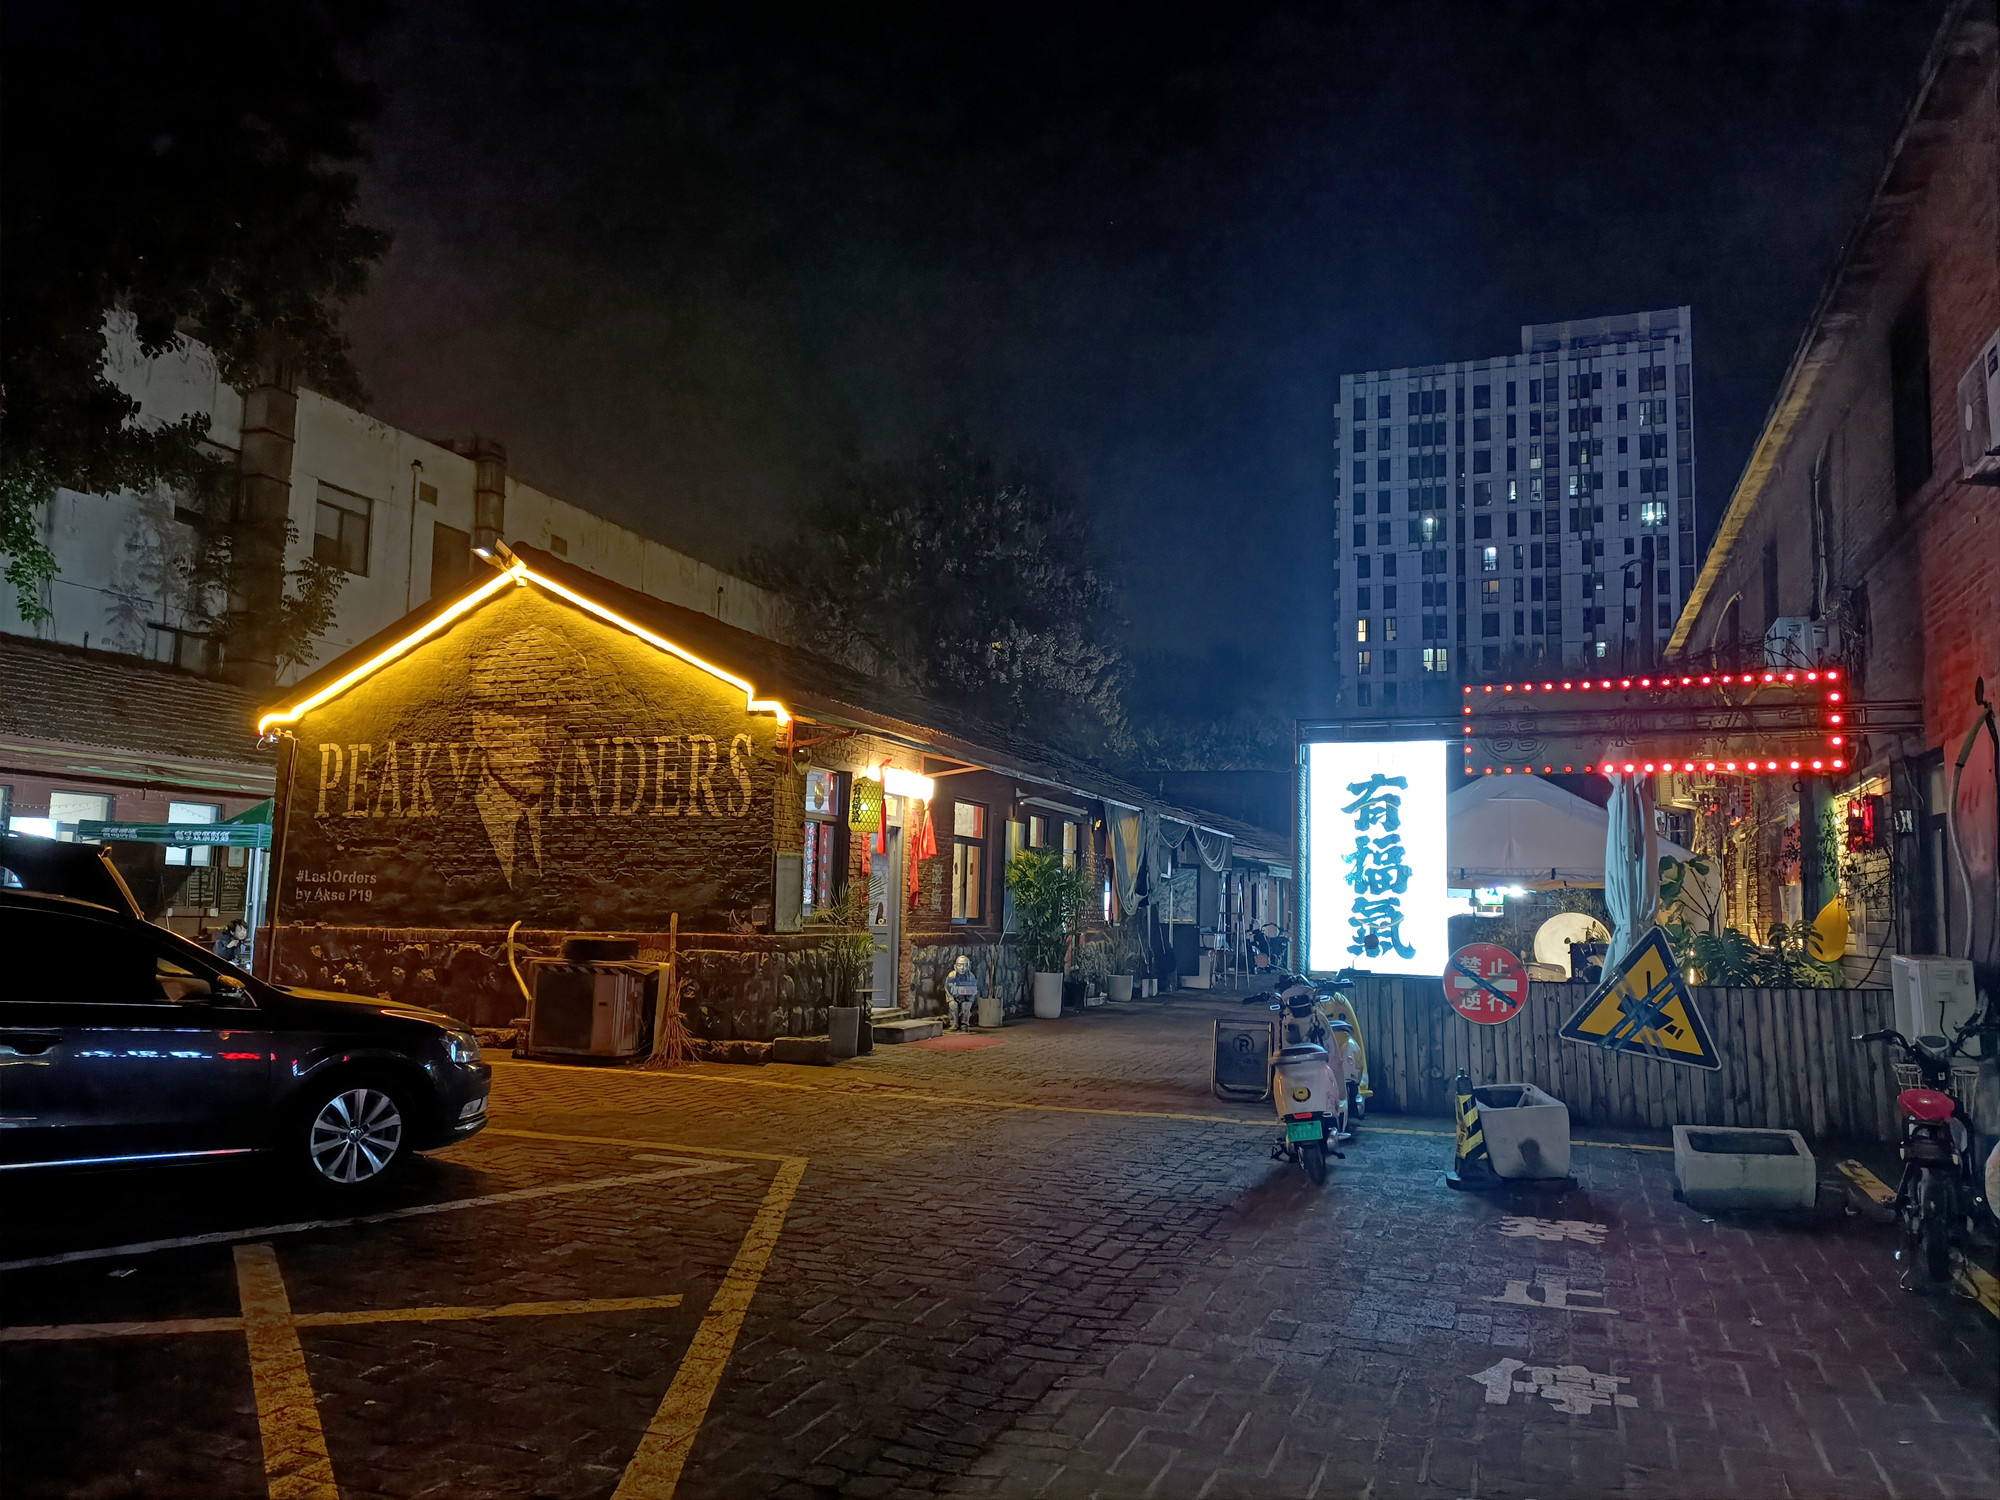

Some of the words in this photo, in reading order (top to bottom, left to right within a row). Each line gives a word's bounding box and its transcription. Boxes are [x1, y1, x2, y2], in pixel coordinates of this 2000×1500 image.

[314, 742, 480, 818] PEAKY
[295, 869, 377, 884] #LastOrders
[296, 887, 311, 903] by
[314, 887, 345, 901] Akse
[349, 888, 373, 902] P19
[1459, 955, 1511, 977] 禁止
[1459, 990, 1510, 1013] 逆行
